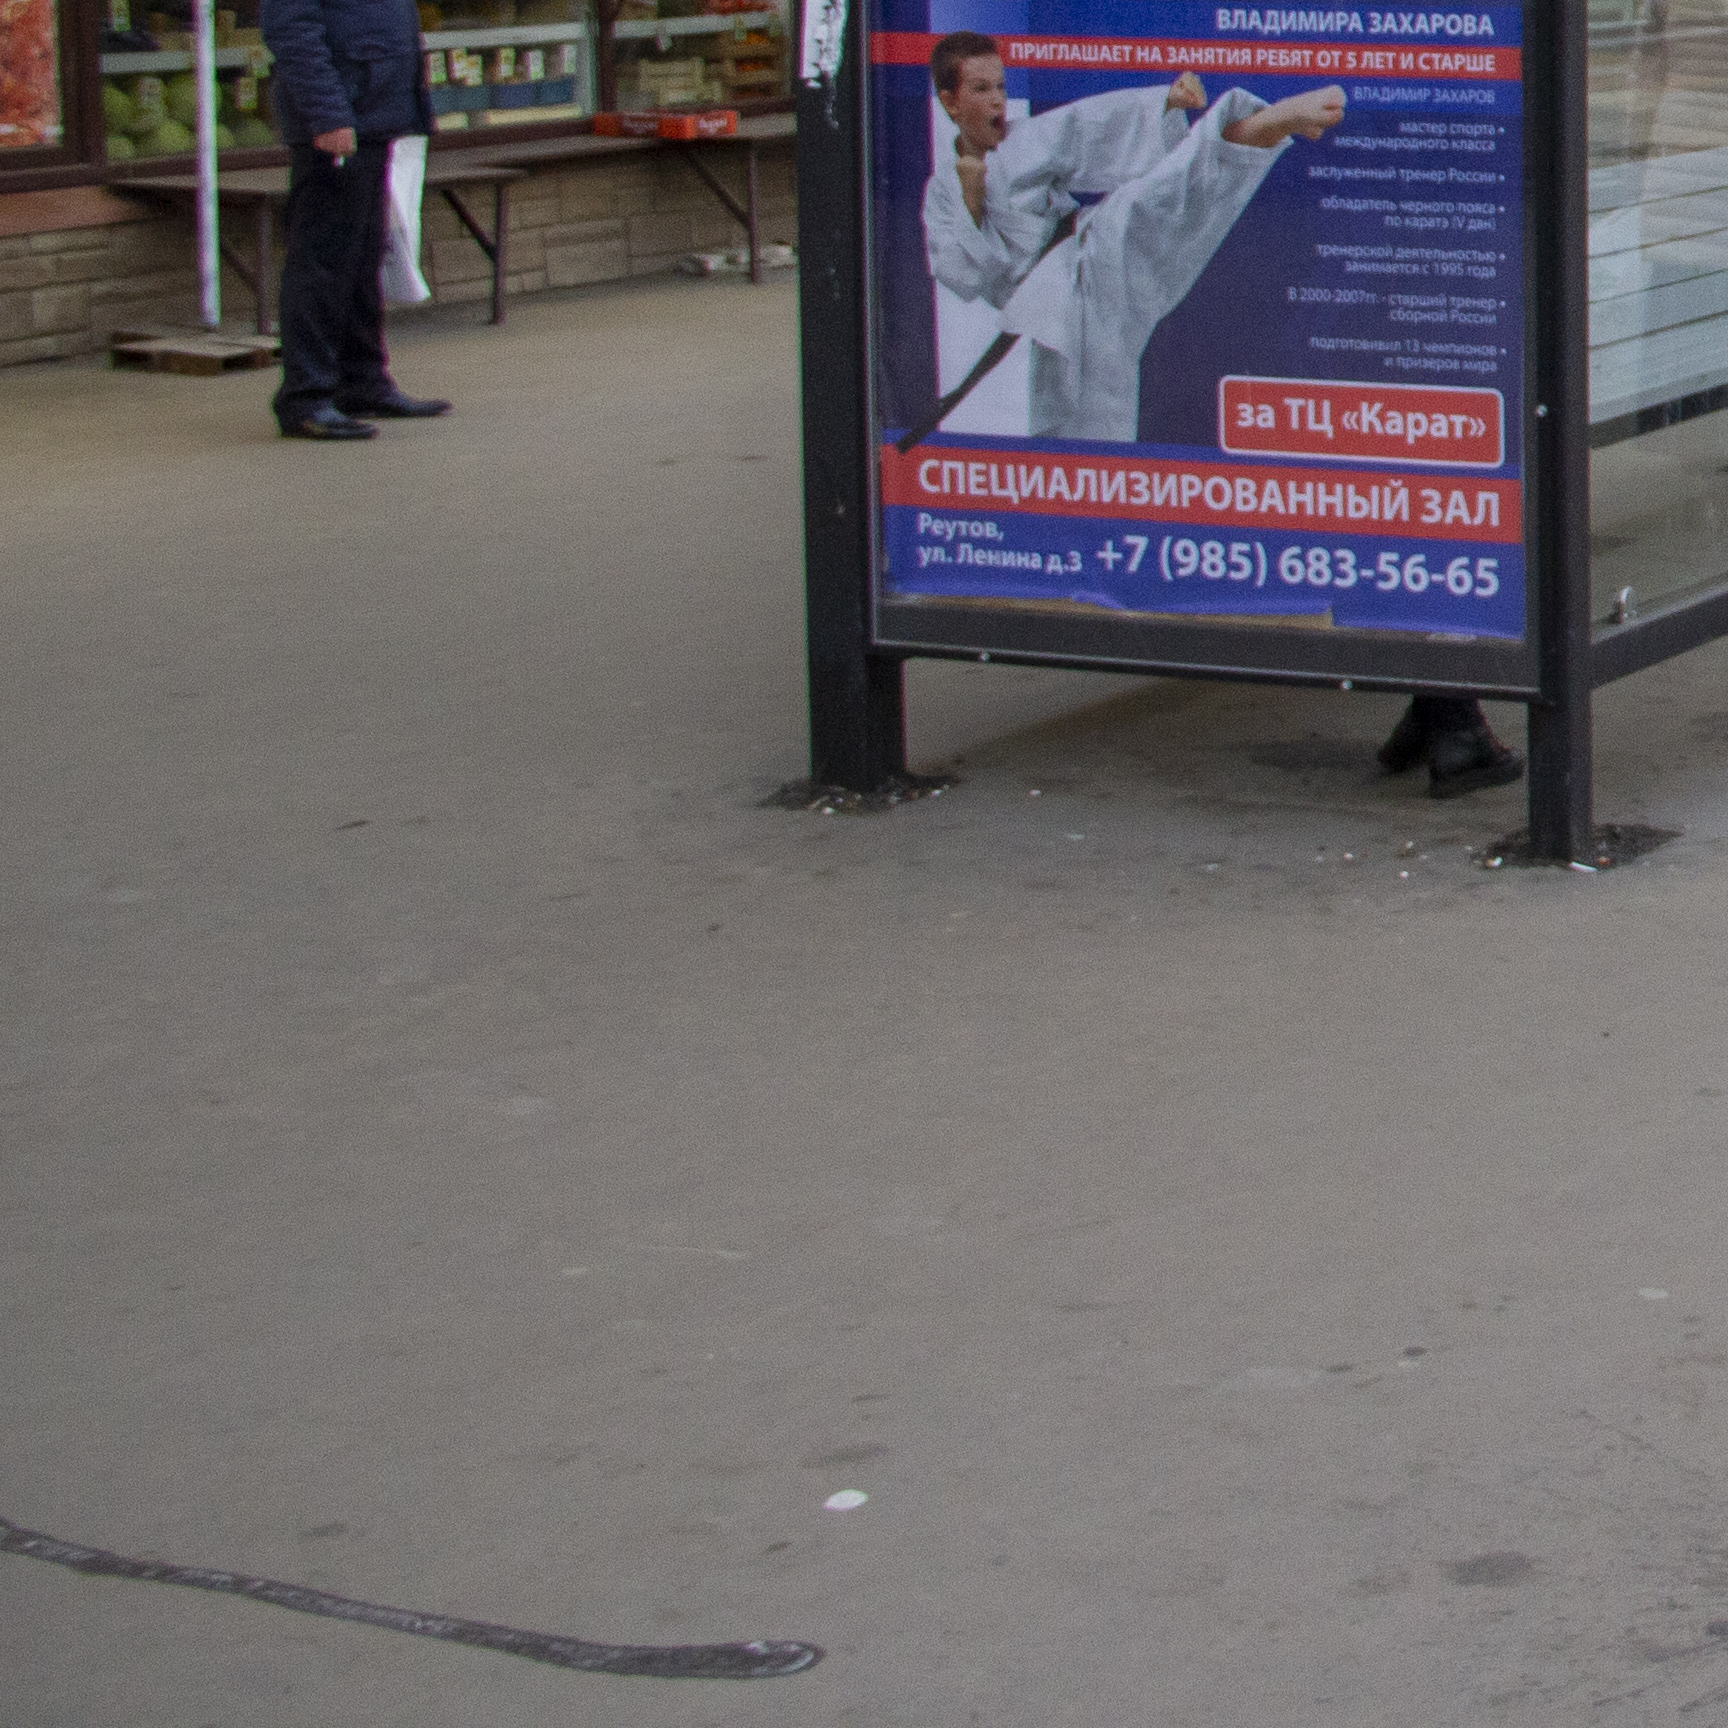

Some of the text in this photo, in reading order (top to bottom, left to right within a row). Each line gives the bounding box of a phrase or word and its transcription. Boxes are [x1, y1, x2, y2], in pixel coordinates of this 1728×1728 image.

[1216, 7, 1496, 37] ВЛАДИМИРА ЗАХАРОВА
[1010, 42, 1496, 72] ПРИГЛАШАЕТ НА ЗАНЯТИЯ РЕБЯТ ОТ 5 ЛЕТ И СТАРШЕ
[1353, 86, 1496, 105] ВЛАДИМИР ЗАХАРОВ
[1399, 122, 1496, 138] мастер спорта
[1236, 397, 1487, 445] за ТЦ «Карат»
[918, 458, 1500, 527] СПЕЦИАЛИЗИРОВАННЫЙ ЗАЛ
[917, 512, 1004, 541] Реутов,
[917, 543, 1083, 574] ул. Ленина д.3
[1096, 534, 1501, 598] +7 (985) 683-56-65
